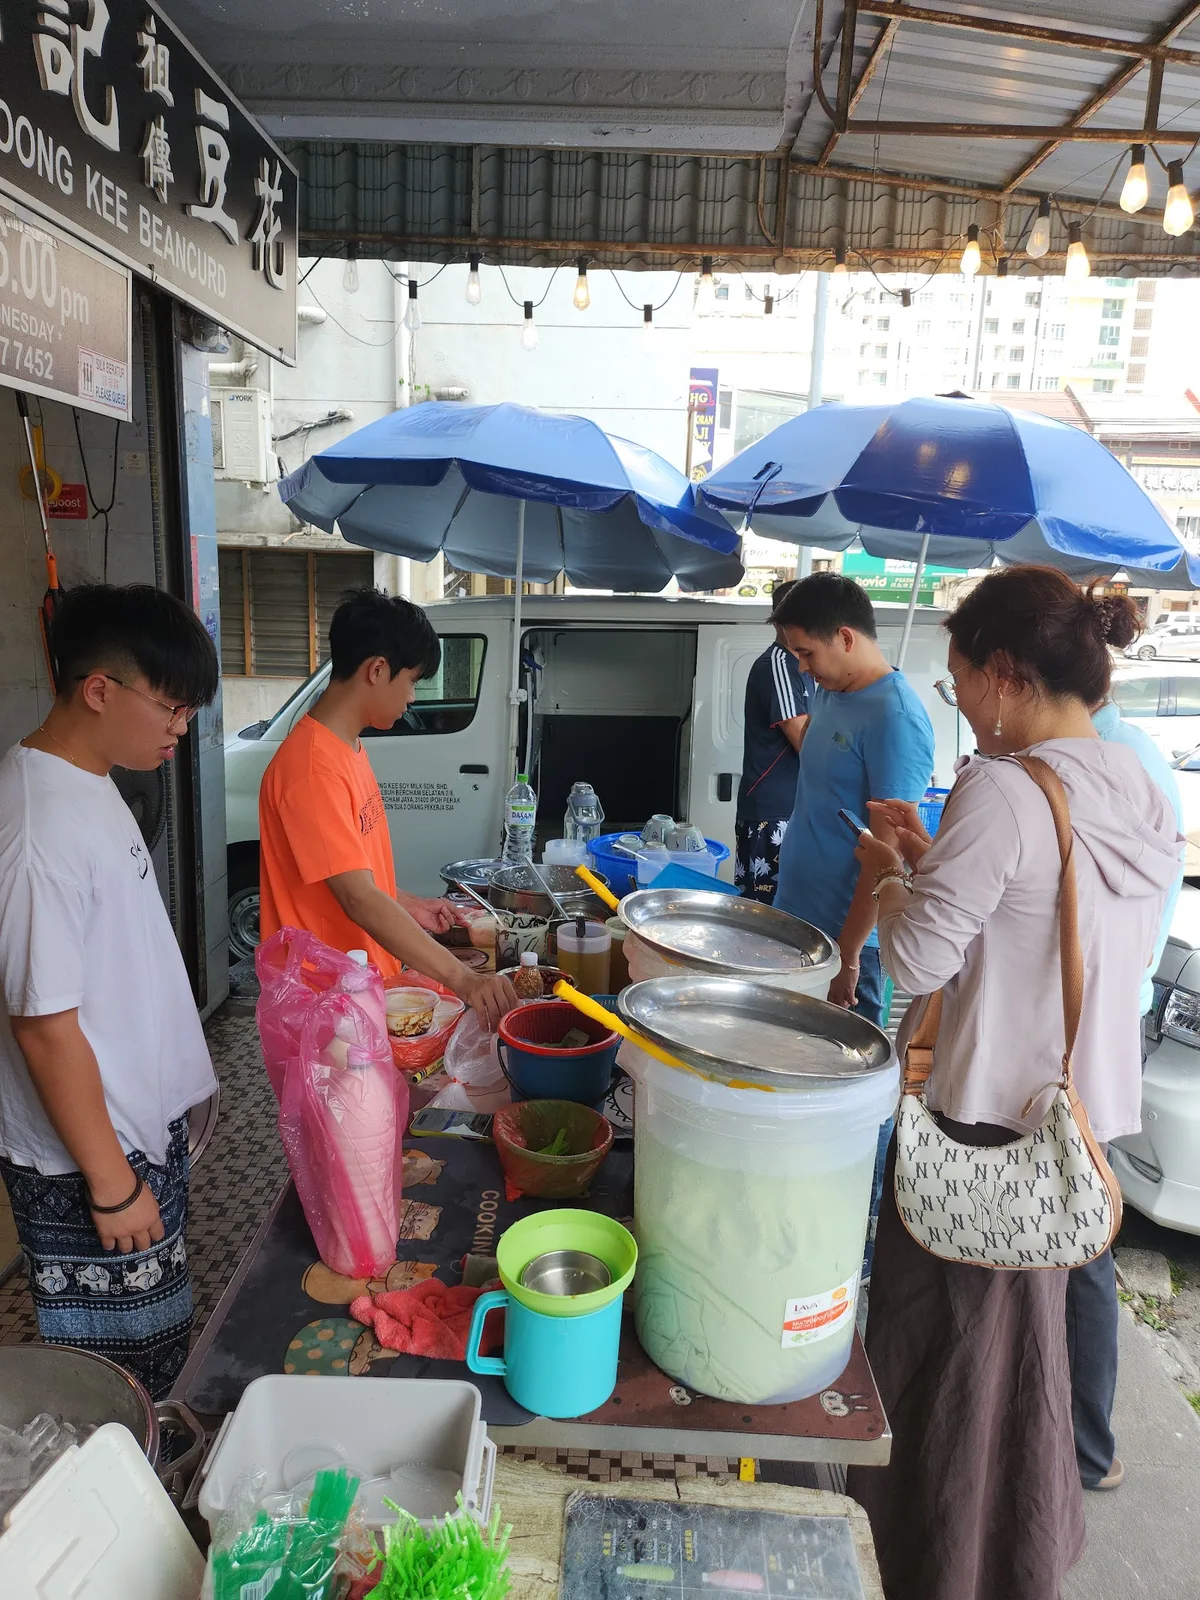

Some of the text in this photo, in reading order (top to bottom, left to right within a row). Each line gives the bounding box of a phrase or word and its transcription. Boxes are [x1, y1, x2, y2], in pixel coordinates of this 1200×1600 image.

[85, 162, 129, 234] KEE
[138, 203, 227, 299] BEANCURD
[60, 285, 89, 325] pm
[13, 340, 54, 381] 7452
[96, 385, 126, 406] PLEASE QUEUE
[794, 1302, 818, 1312] LAVA
